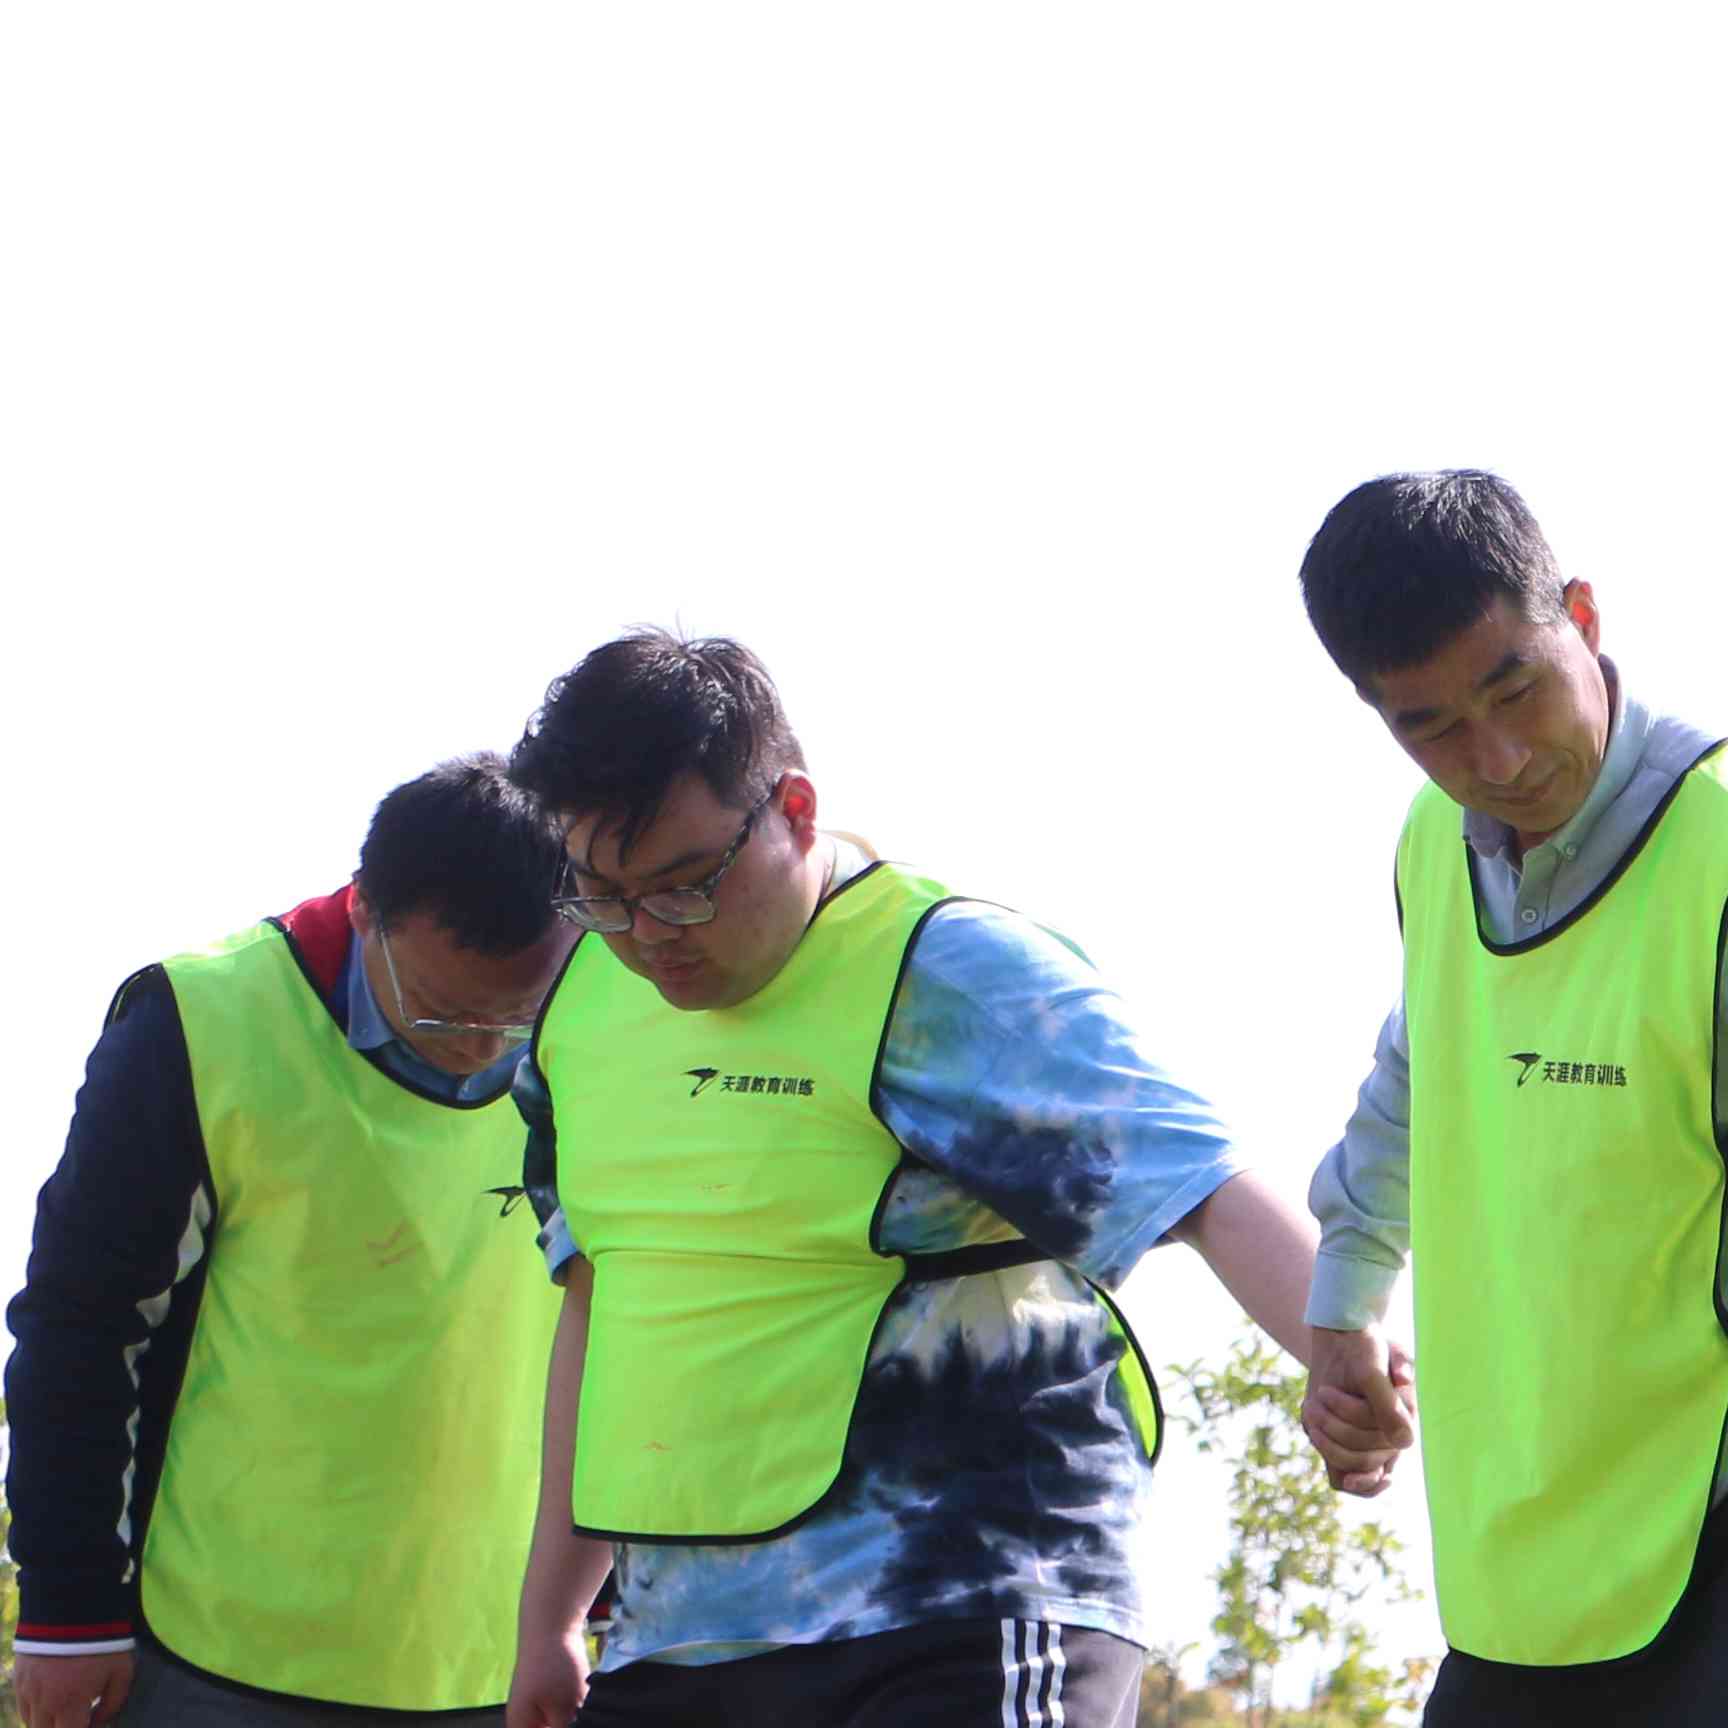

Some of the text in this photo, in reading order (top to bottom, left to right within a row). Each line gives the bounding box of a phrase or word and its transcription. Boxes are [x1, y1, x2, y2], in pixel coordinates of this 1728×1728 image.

[720, 1075, 816, 1096] 天涯教育训练
[1542, 1061, 1628, 1087] 天涯教育训练
